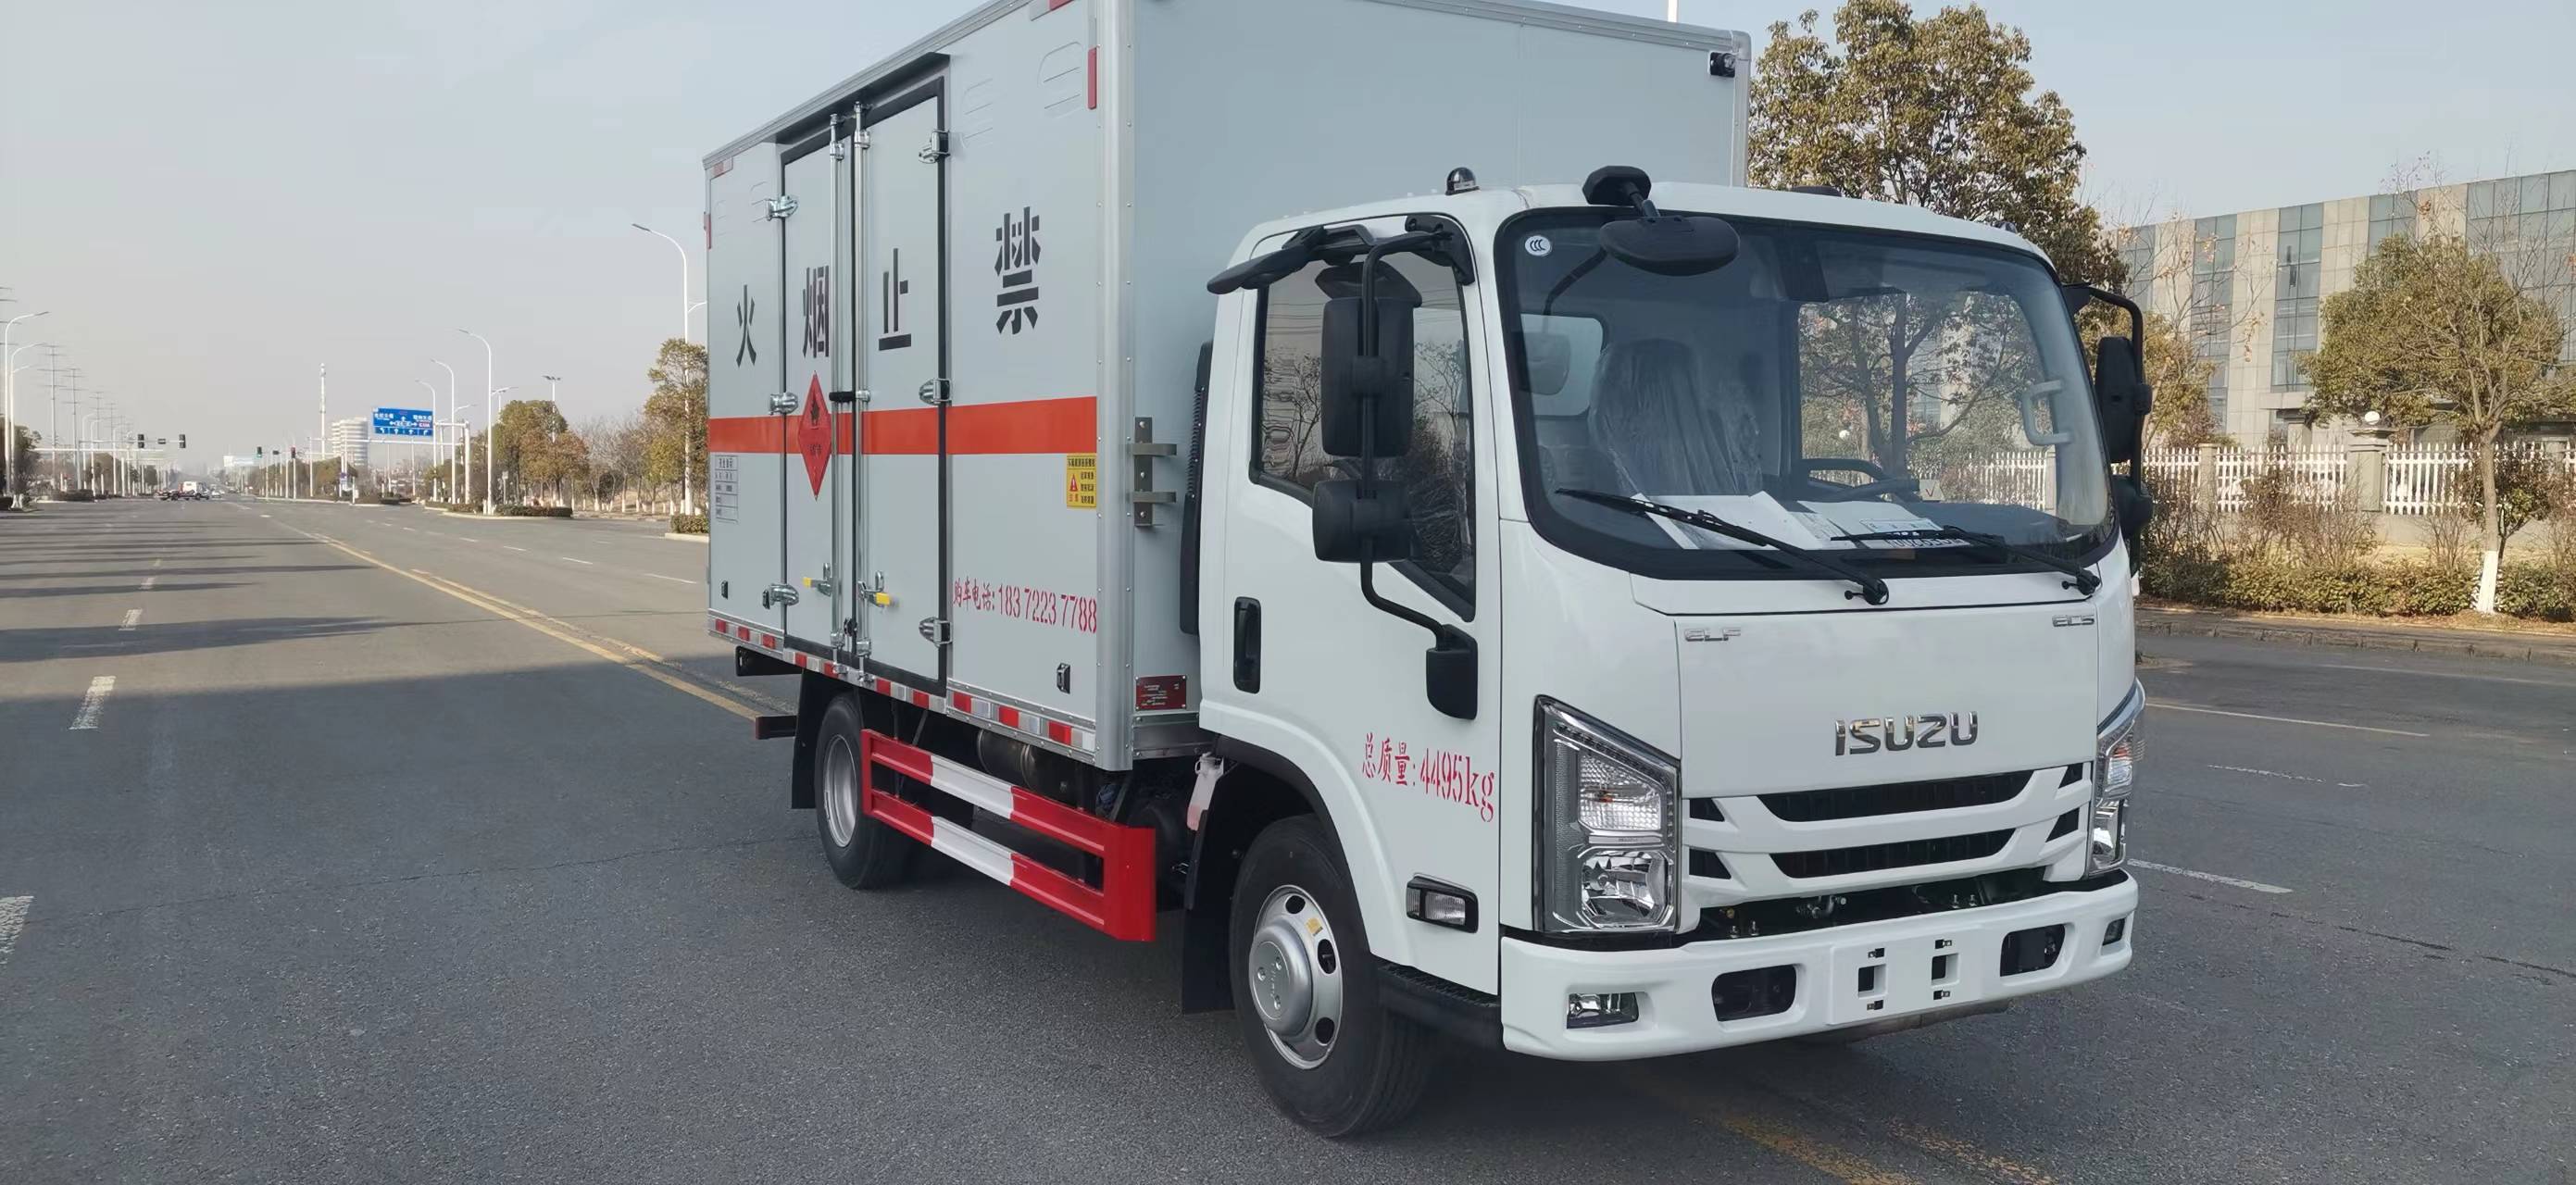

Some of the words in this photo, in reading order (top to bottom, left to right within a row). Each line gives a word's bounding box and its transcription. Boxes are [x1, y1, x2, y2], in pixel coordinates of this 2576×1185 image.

[736, 284, 757, 368] 火
[879, 247, 911, 351] 止
[994, 206, 1041, 335] 禁
[1684, 627, 1741, 642] ELF
[1835, 711, 1978, 756] ISUZU
